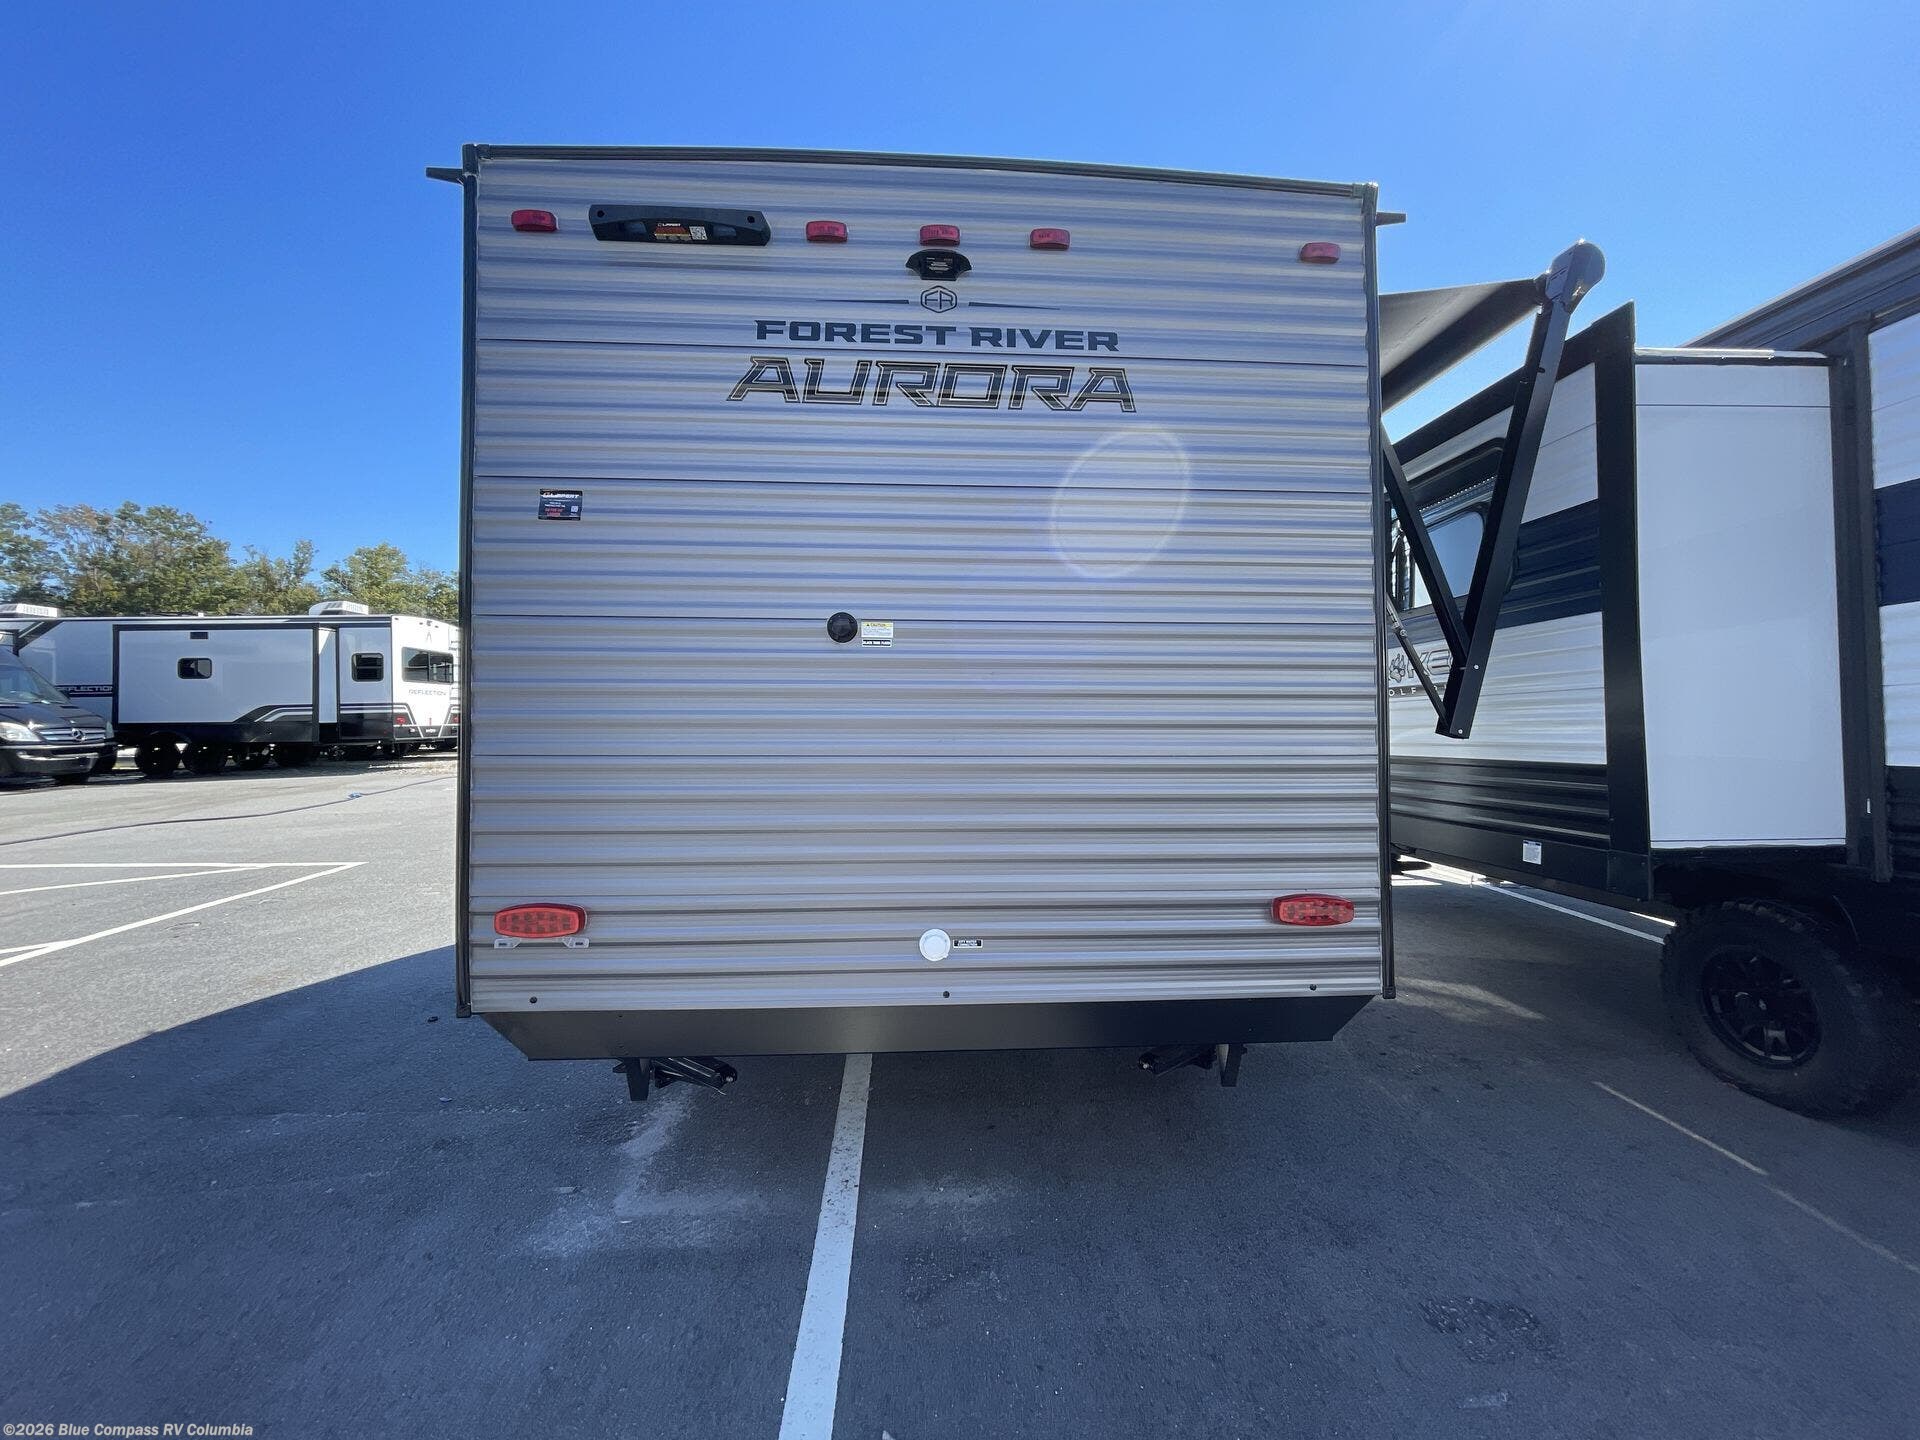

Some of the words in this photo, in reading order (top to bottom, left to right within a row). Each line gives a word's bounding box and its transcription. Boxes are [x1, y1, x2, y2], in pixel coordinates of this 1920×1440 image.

[754, 319, 957, 346] FOREST
[968, 326, 1120, 352] RIVER
[726, 355, 1137, 413] AURORA
[1388, 687, 1417, 697] OLF
